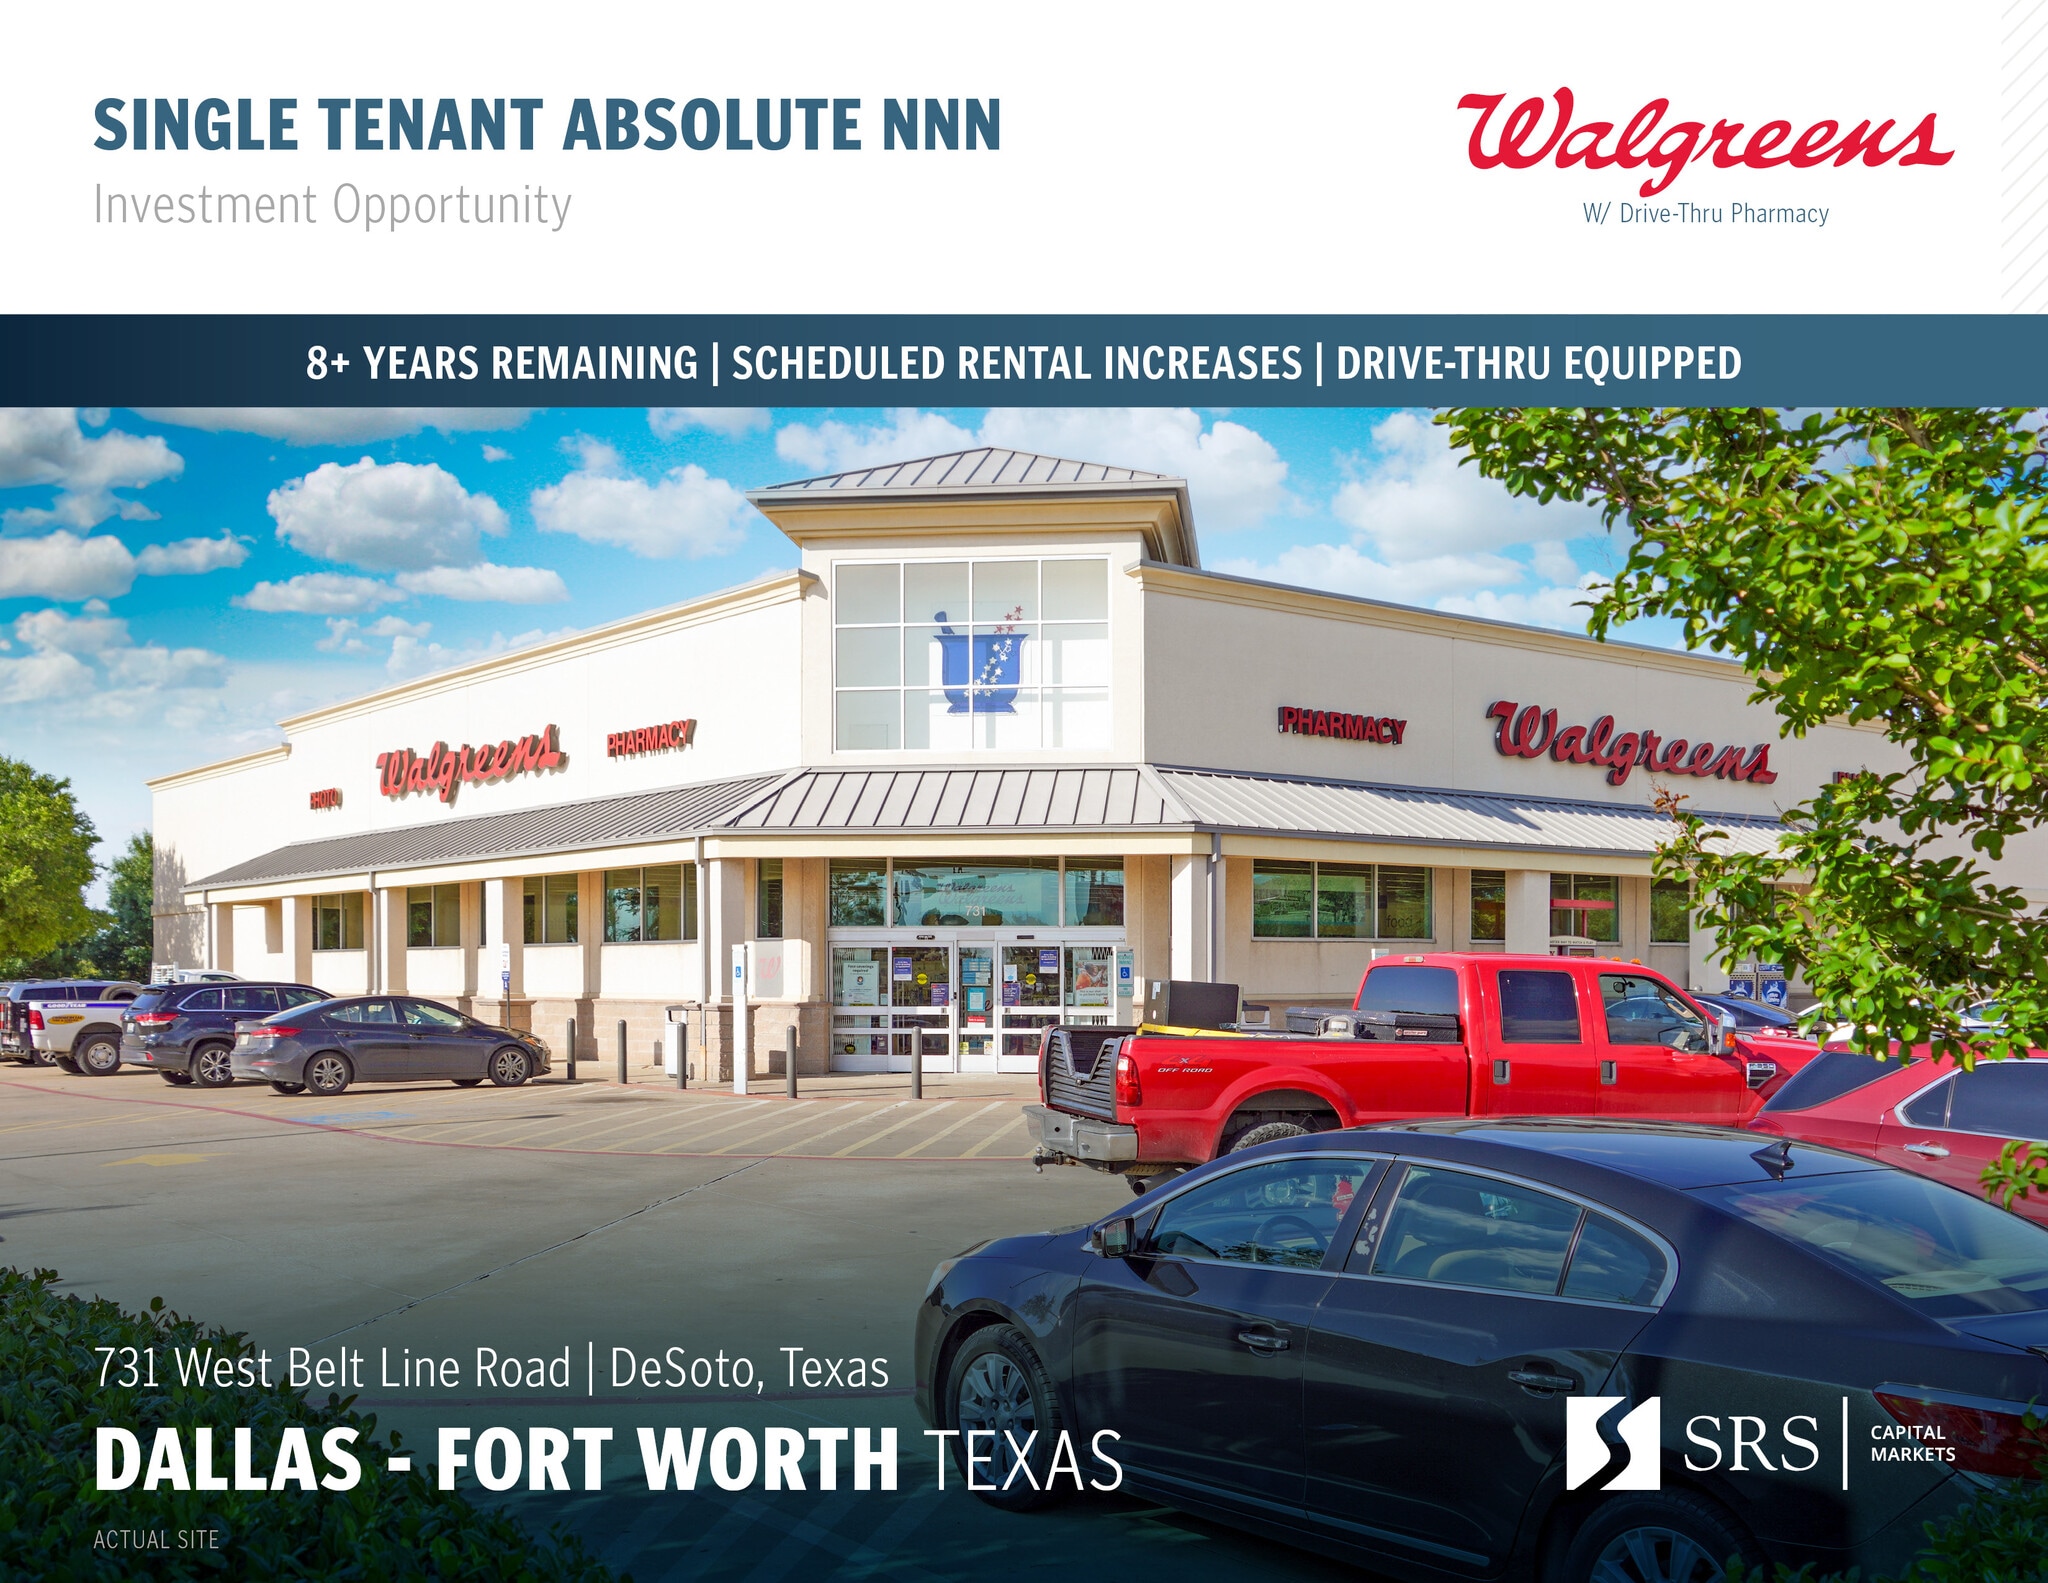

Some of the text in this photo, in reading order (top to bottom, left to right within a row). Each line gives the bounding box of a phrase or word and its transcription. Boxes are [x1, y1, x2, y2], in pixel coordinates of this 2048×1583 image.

[607, 719, 697, 759] PHARMACY
[1279, 706, 1406, 744] PHARMACY
[1487, 701, 1777, 785] Walgreens
[376, 723, 567, 803] Walgreens
[309, 788, 342, 810] PHOTO
[965, 905, 986, 917] 731
